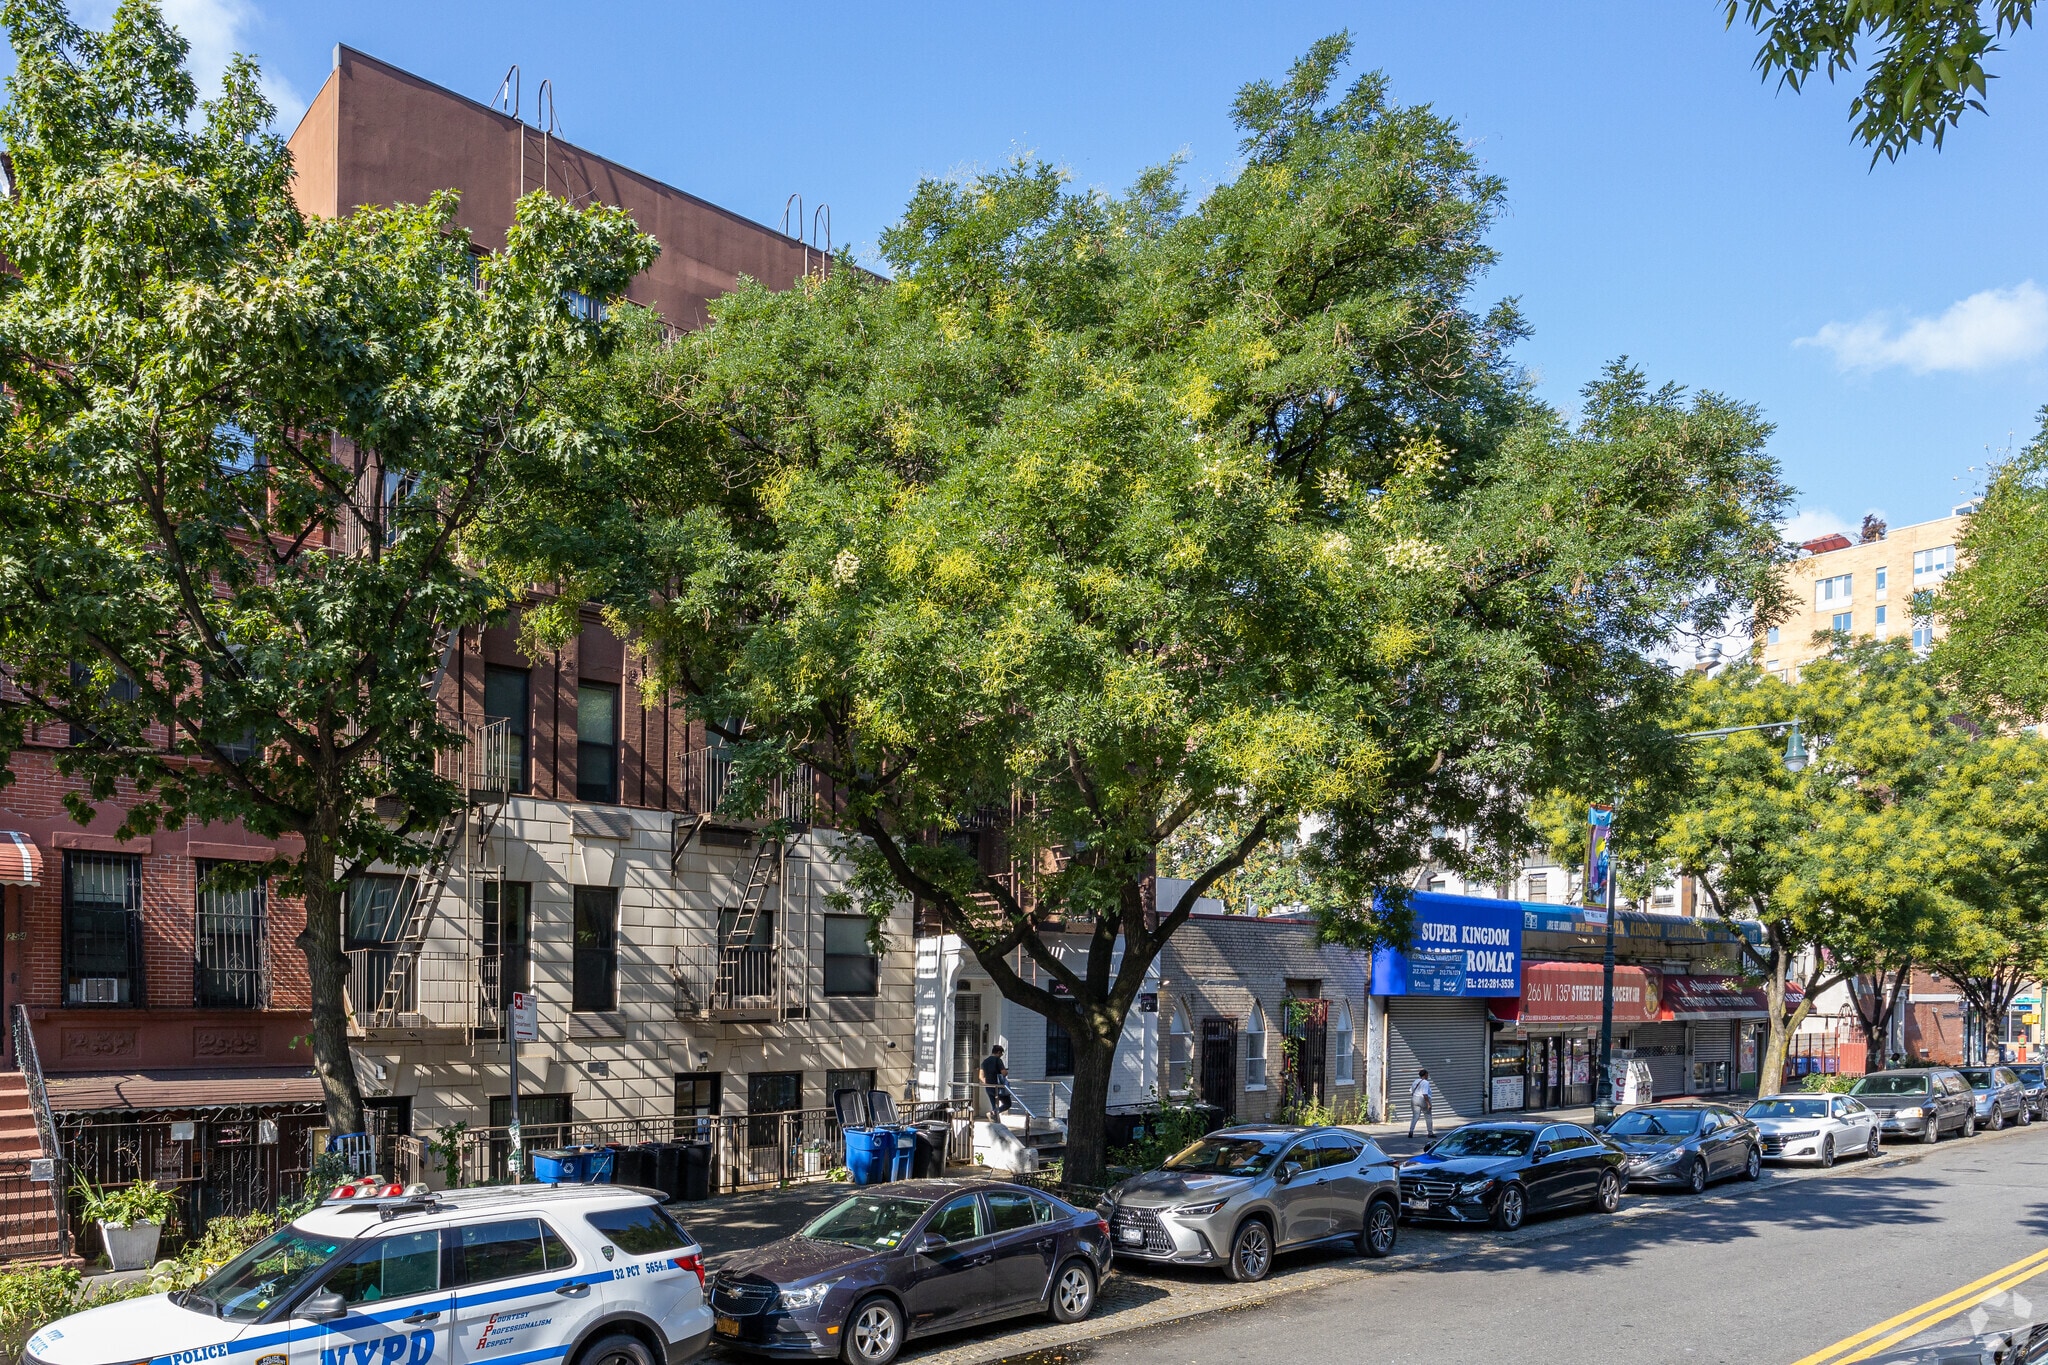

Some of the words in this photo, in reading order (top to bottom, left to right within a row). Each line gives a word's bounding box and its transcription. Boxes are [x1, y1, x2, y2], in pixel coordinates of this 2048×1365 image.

[1421, 922, 1457, 943] SUPER
[1461, 925, 1510, 946] KINGDOM
[1477, 978, 1515, 989] 212-281-3536
[1527, 982, 1542, 1002] 266
[1543, 983, 1553, 1002] W.
[1571, 985, 1594, 1002] STREET
[614, 1267, 625, 1280] 32
[625, 1264, 641, 1278] PCT
[645, 1260, 664, 1274] 5654
[482, 1318, 553, 1337] PROFESSIONALISM
[489, 1312, 530, 1325] COURTESY
[475, 1336, 515, 1350] RESPECT
[172, 1343, 227, 1365] POLICE
